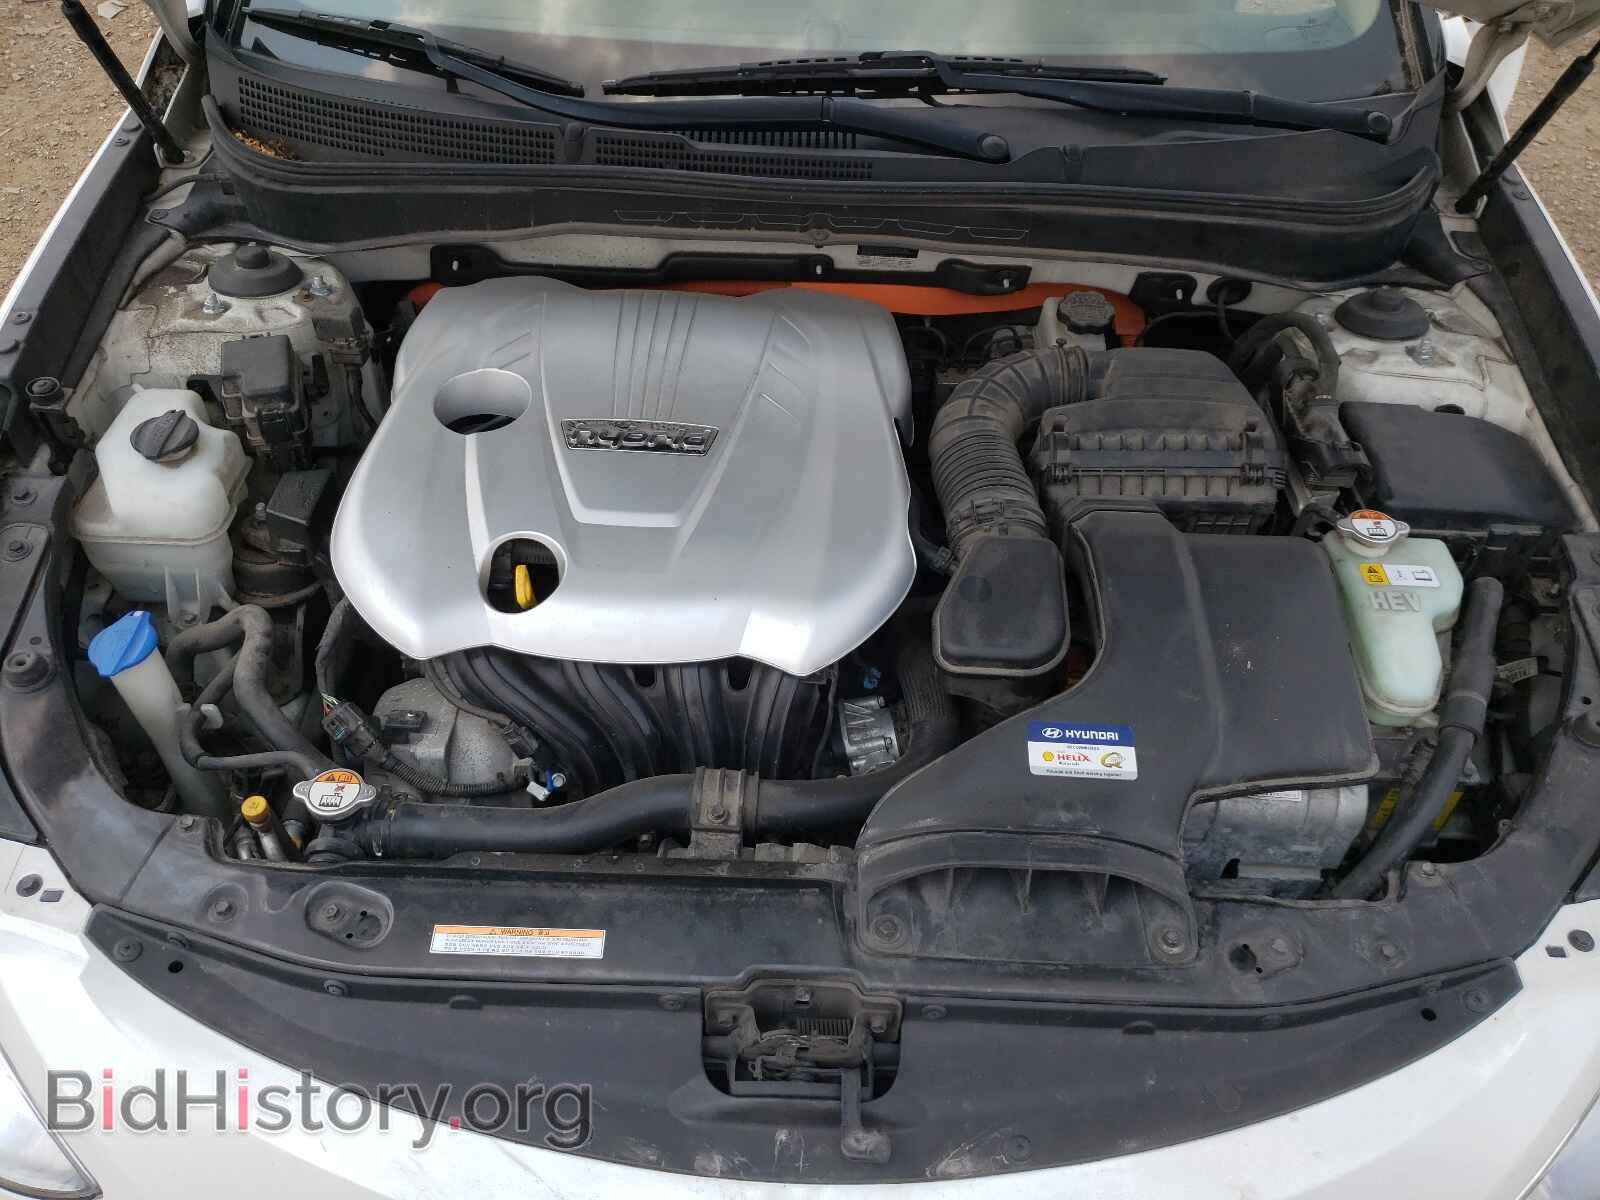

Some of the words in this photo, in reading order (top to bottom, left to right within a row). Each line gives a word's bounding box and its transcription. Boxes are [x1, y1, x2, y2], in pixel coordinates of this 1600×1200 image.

[1370, 591, 1424, 612] HEV
[1065, 729, 1119, 740] HYUNDAI
[1057, 752, 1090, 762] HELIX
